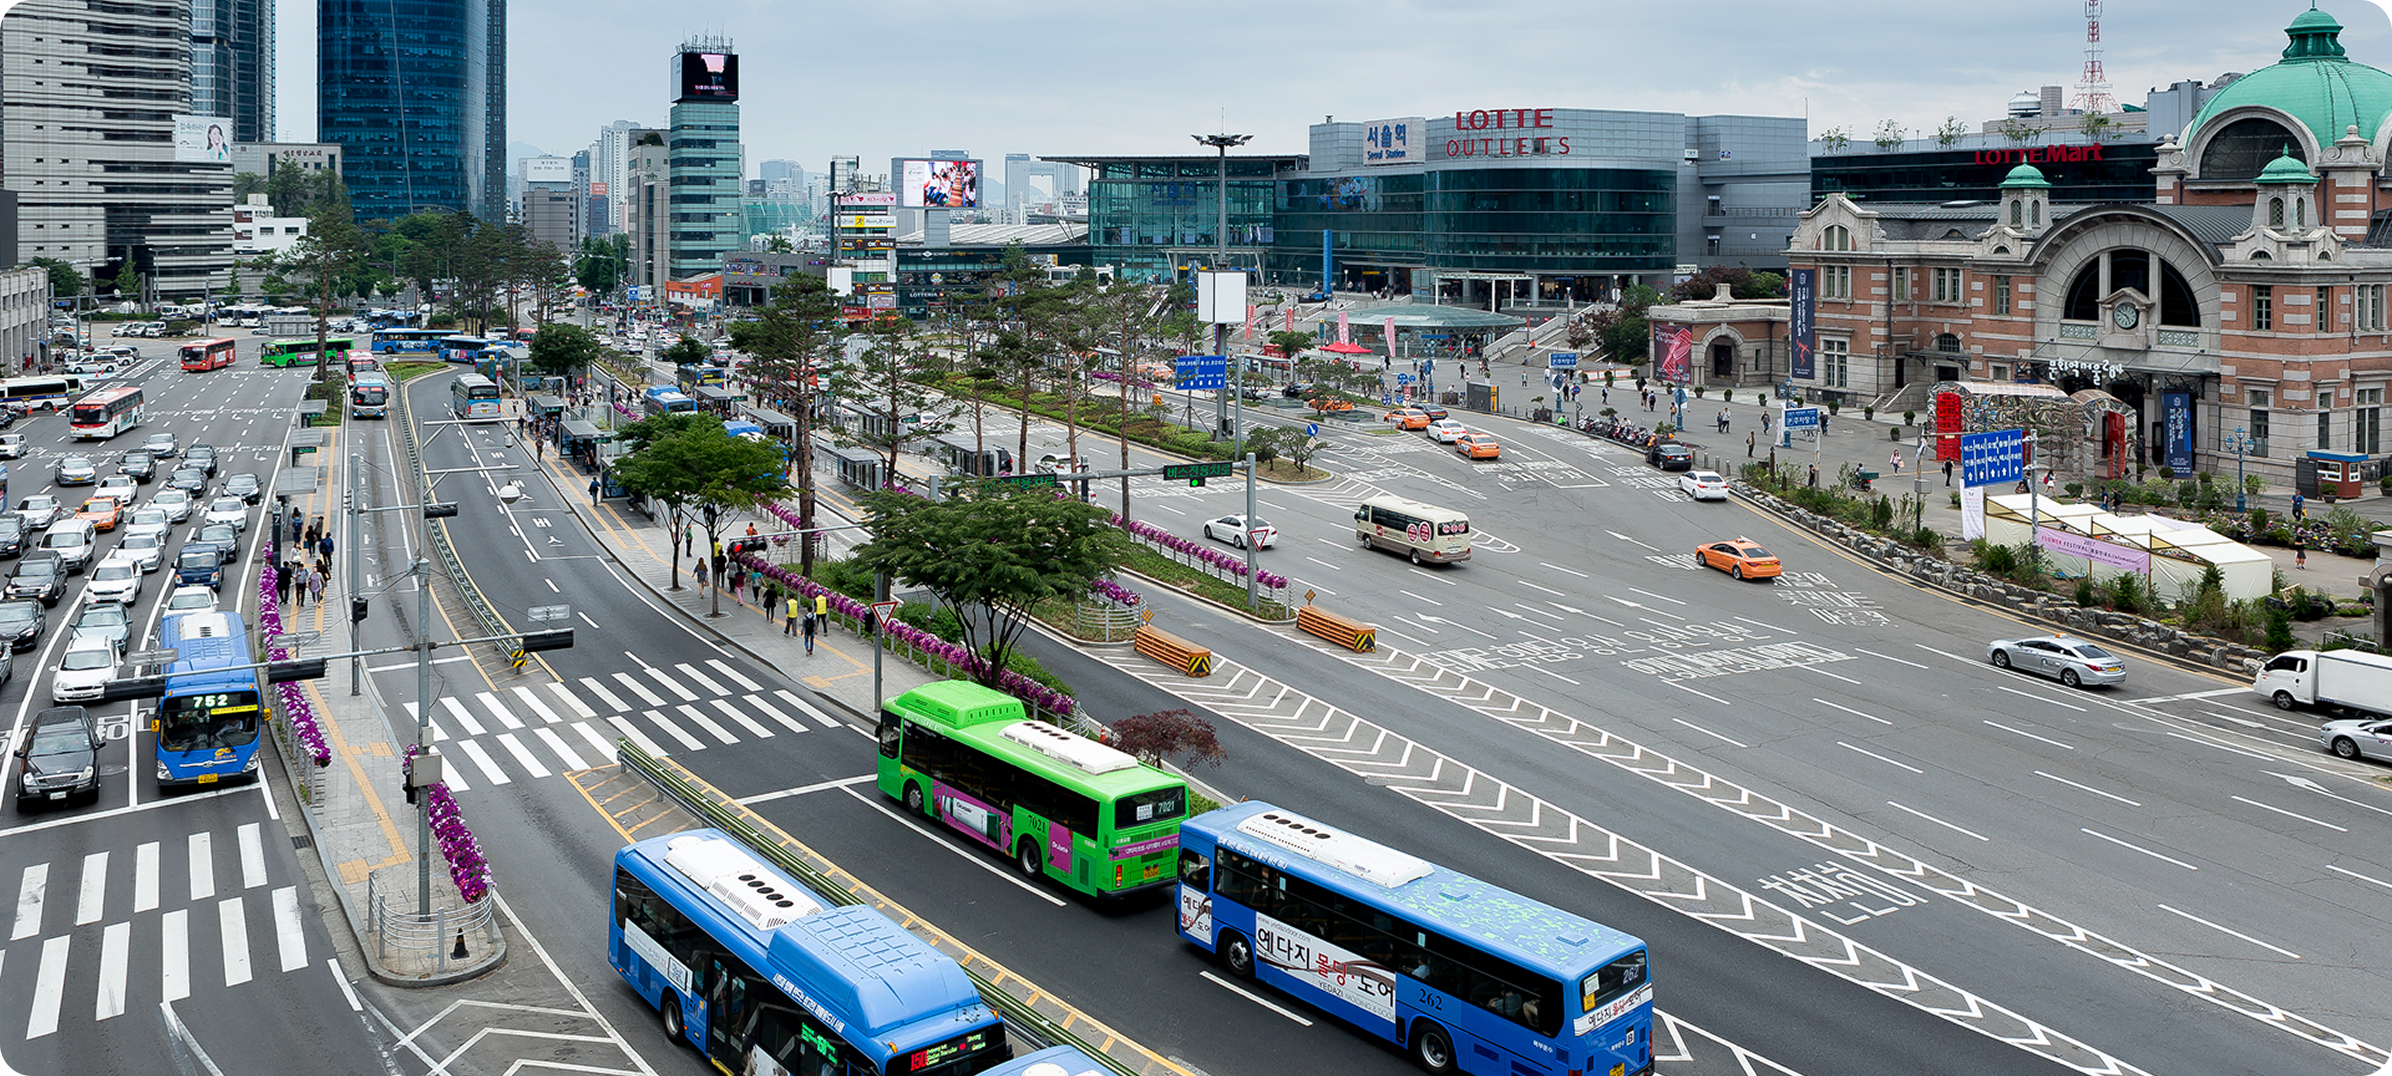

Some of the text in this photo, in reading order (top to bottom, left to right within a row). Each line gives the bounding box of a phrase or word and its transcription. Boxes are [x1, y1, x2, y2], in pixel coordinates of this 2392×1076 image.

[1456, 108, 1554, 131] LOTTE
[1367, 123, 1406, 148] 서울역
[1367, 149, 1406, 161] Seoul Station
[1446, 136, 1570, 157] OUTLETS
[1975, 142, 2103, 165] LOTTE Mart
[1150, 181, 1196, 198] 서울역
[2048, 358, 2124, 386] 문화역서울284
[1167, 463, 1231, 479] 버스전용차로
[274, 516, 280, 525] 7
[533, 517, 566, 547] 버스
[2041, 535, 2063, 545] FLOWER
[2063, 540, 2088, 552] FESTIVAL
[2083, 539, 2097, 547] 2017
[1773, 589, 1885, 609] 롯데마트
[1624, 627, 1711, 649] 용산
[1686, 620, 1772, 642] 용산
[1560, 633, 1647, 656] 용산
[193, 694, 228, 708] 752
[1158, 801, 1175, 814] 7021
[1027, 815, 1046, 833] 7021
[1757, 861, 1930, 926] 천천히
[1182, 894, 1212, 920] 예다지
[1258, 928, 1310, 970] 예다지
[1623, 966, 1639, 984] 262
[1317, 979, 1344, 997] YEDAZI
[1418, 988, 1443, 1011] 262
[1588, 1008, 1611, 1027] 예다지
[1627, 1032, 1634, 1044] B
[910, 1050, 928, 1071] 150
